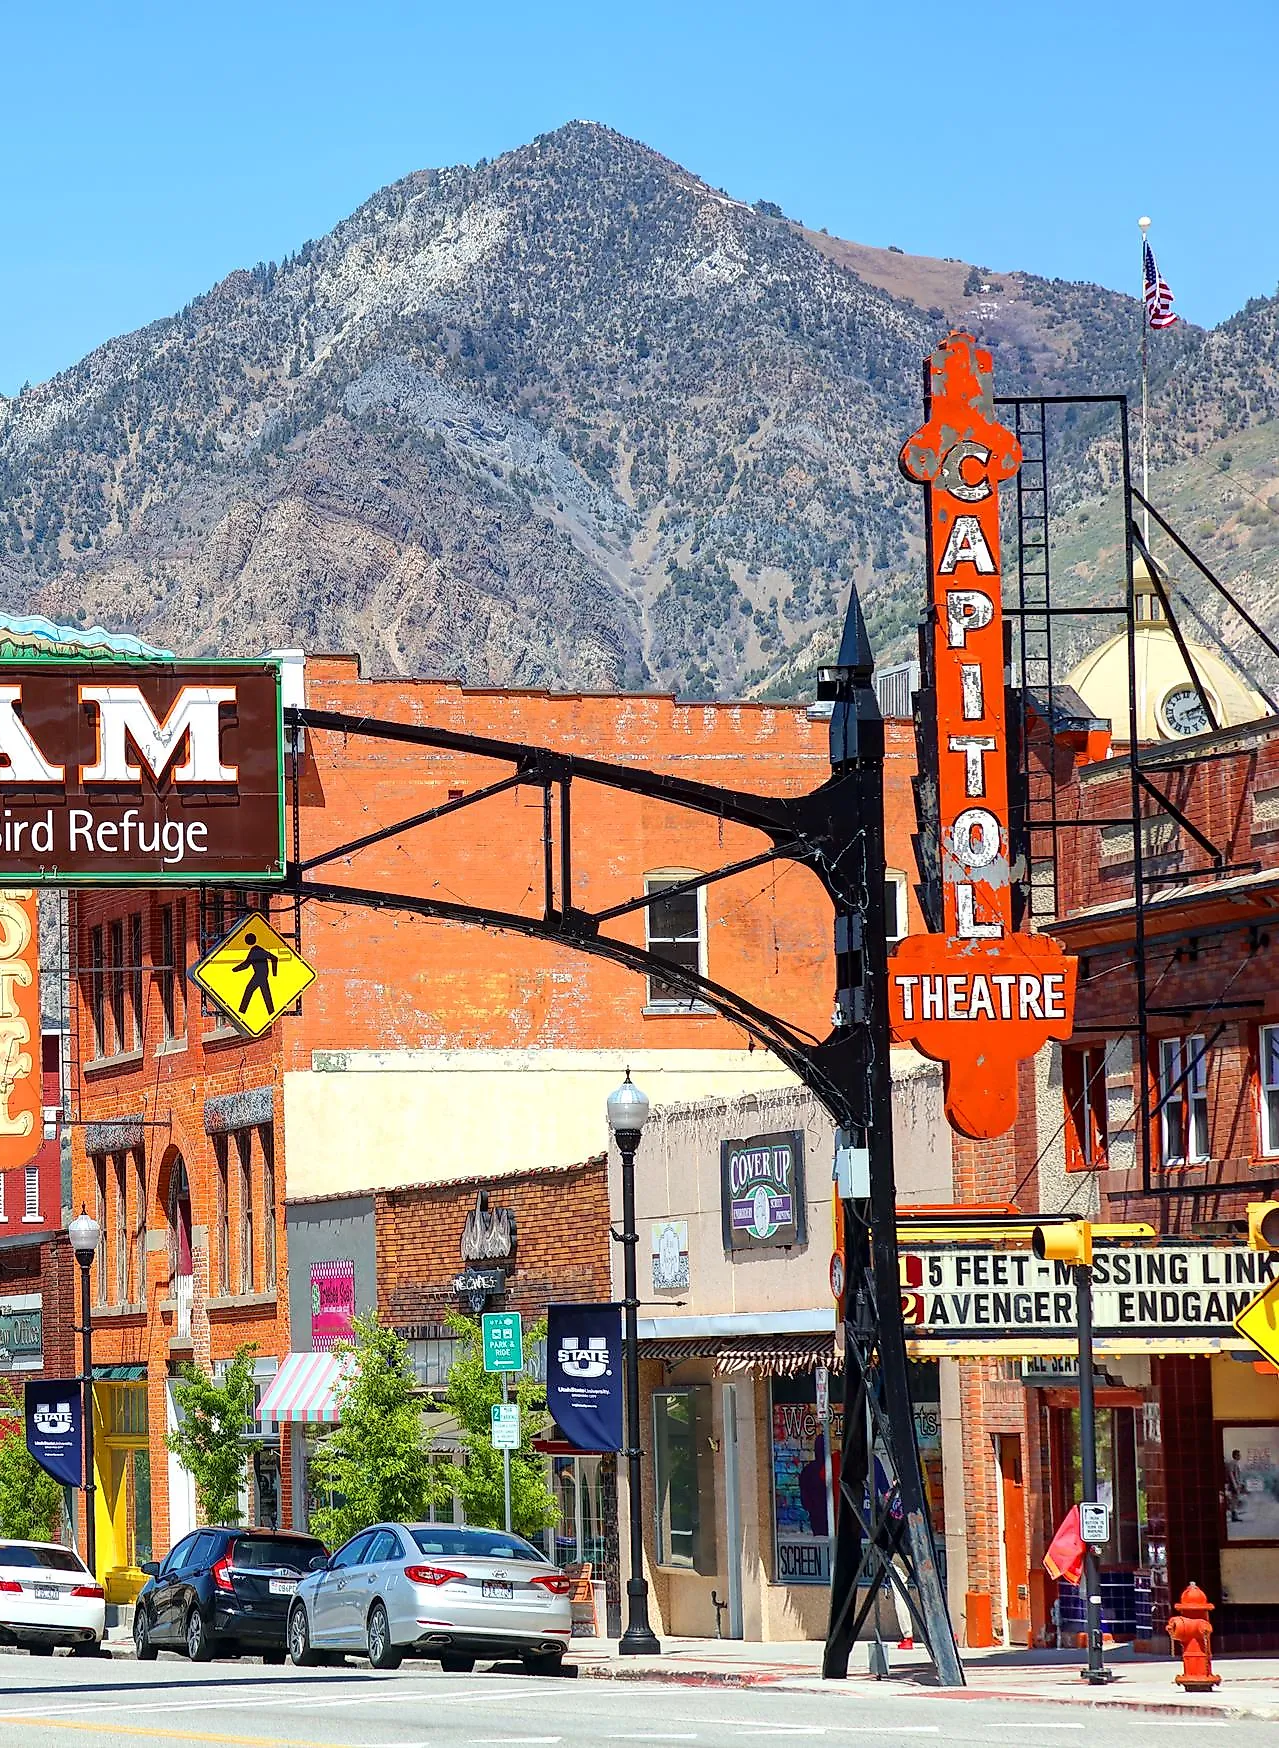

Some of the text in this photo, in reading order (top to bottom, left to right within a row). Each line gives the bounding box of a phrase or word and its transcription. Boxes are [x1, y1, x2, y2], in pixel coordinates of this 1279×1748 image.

[937, 439, 1004, 941] CAPITOL
[69, 809, 209, 862] Refuge
[894, 972, 1068, 1023] THEATRE
[730, 1150, 790, 1194] COVER UP
[928, 1255, 942, 1286] 5
[1202, 1253, 1273, 1285] LINK
[900, 1290, 1259, 1326] 2 AVENGER ENDGAM
[14, 1318, 39, 1345] Office
[489, 1341, 507, 1349] PARK
[557, 1349, 610, 1364] STATE
[33, 1412, 73, 1423] STATE
[493, 1407, 500, 1420] 2
[781, 1405, 817, 1436] We
[780, 1545, 822, 1577] SCREEN
